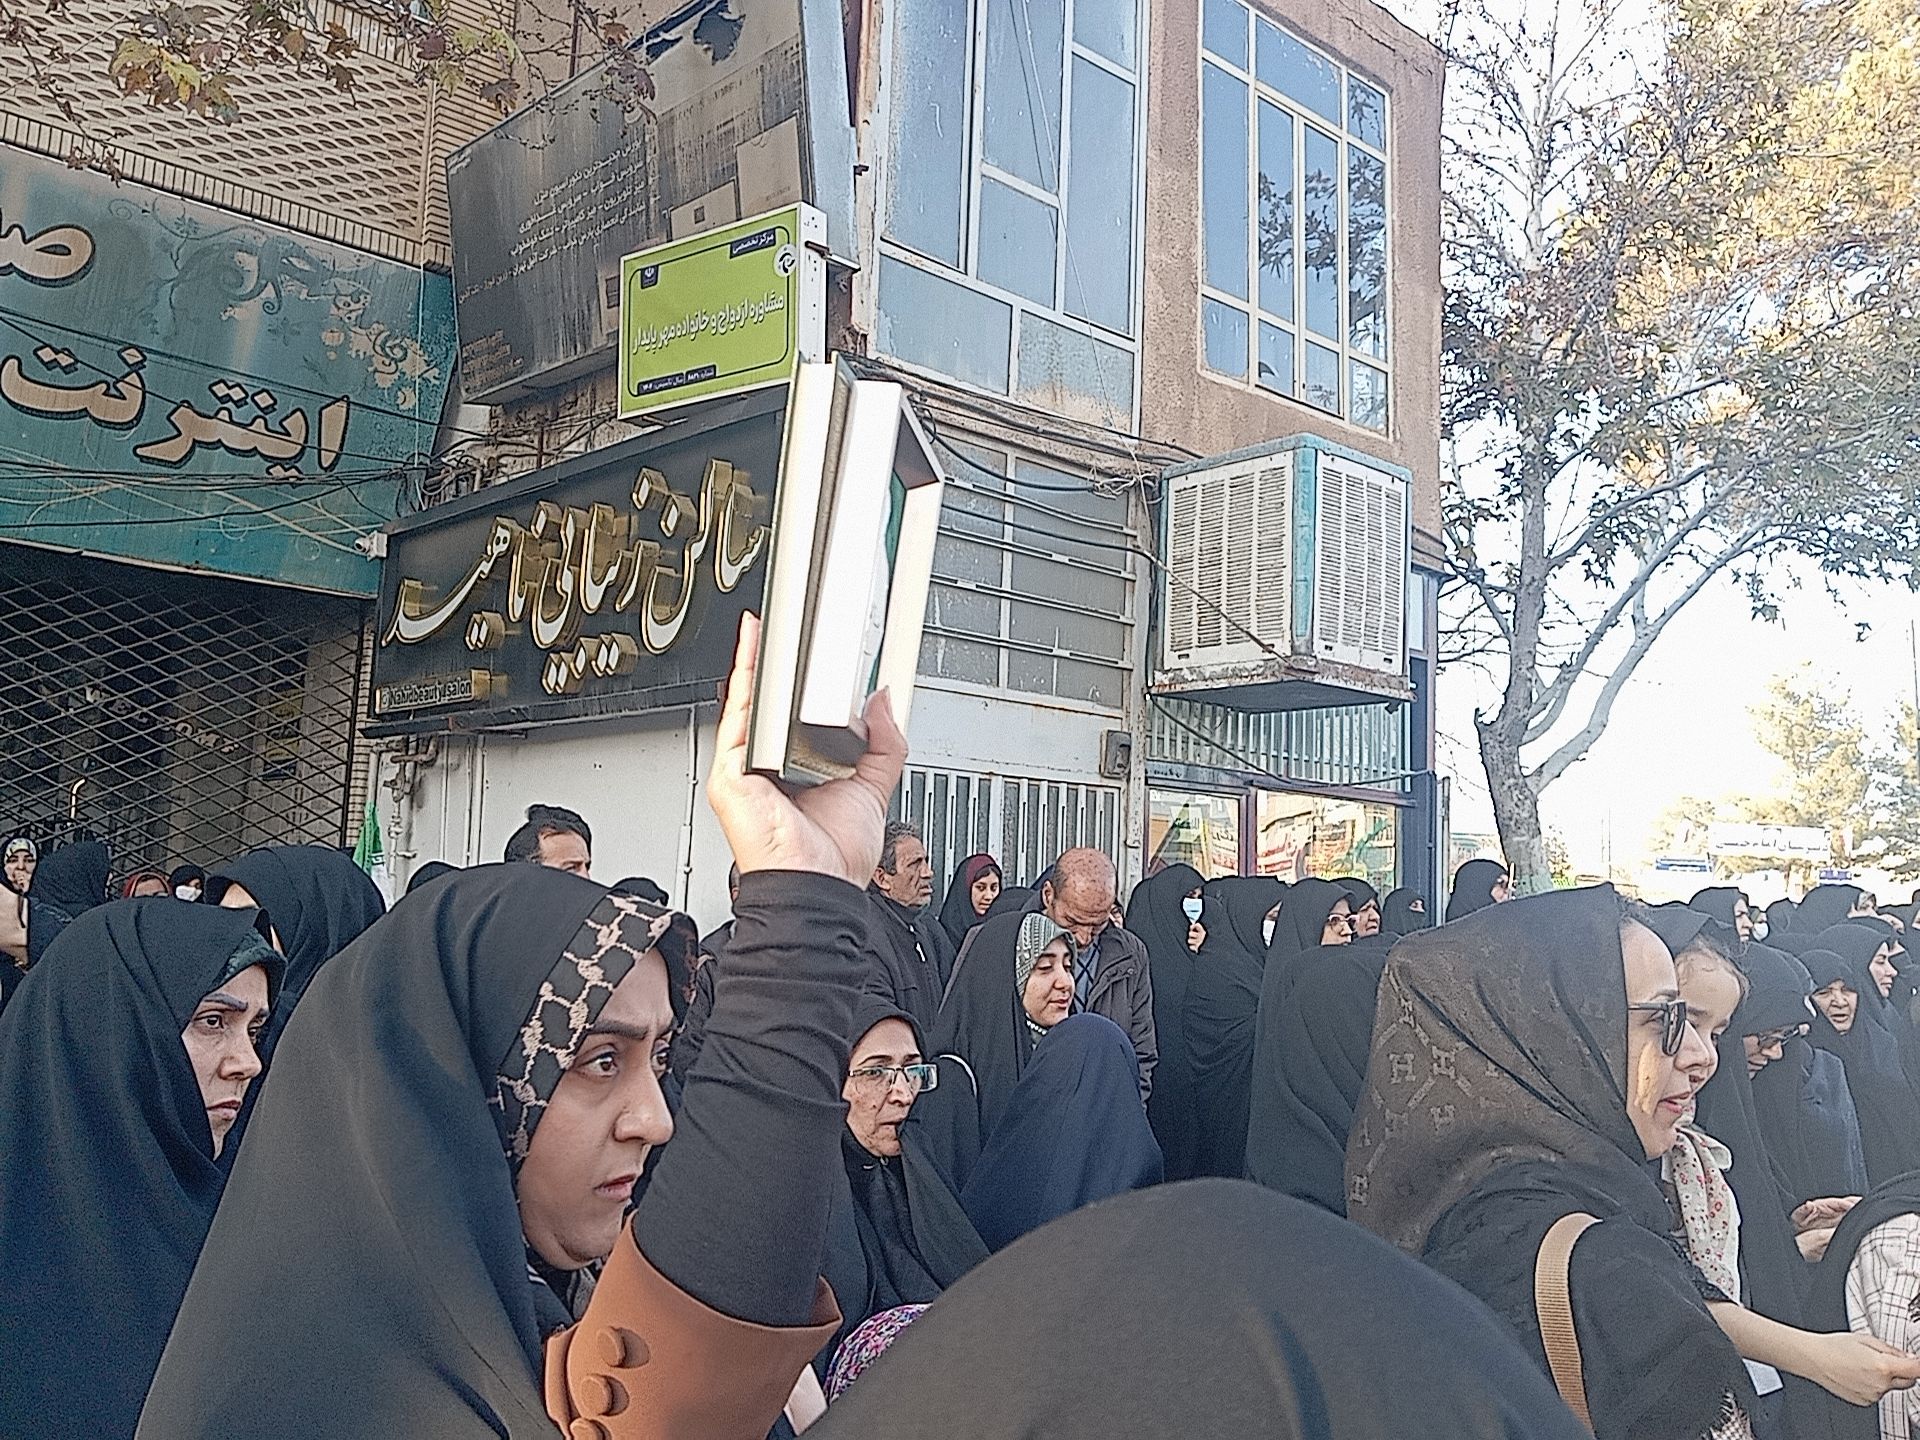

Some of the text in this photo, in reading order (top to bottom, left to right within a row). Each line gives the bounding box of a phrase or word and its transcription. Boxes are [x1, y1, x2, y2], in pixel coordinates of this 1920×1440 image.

[759, 232, 775, 246] مرکز
[632, 290, 785, 354] مشاوره ازدواج و خانواده مهر پایدار
[1, 346, 351, 488] اینترنت
[382, 459, 771, 696] سالن زیبایی ناهید
